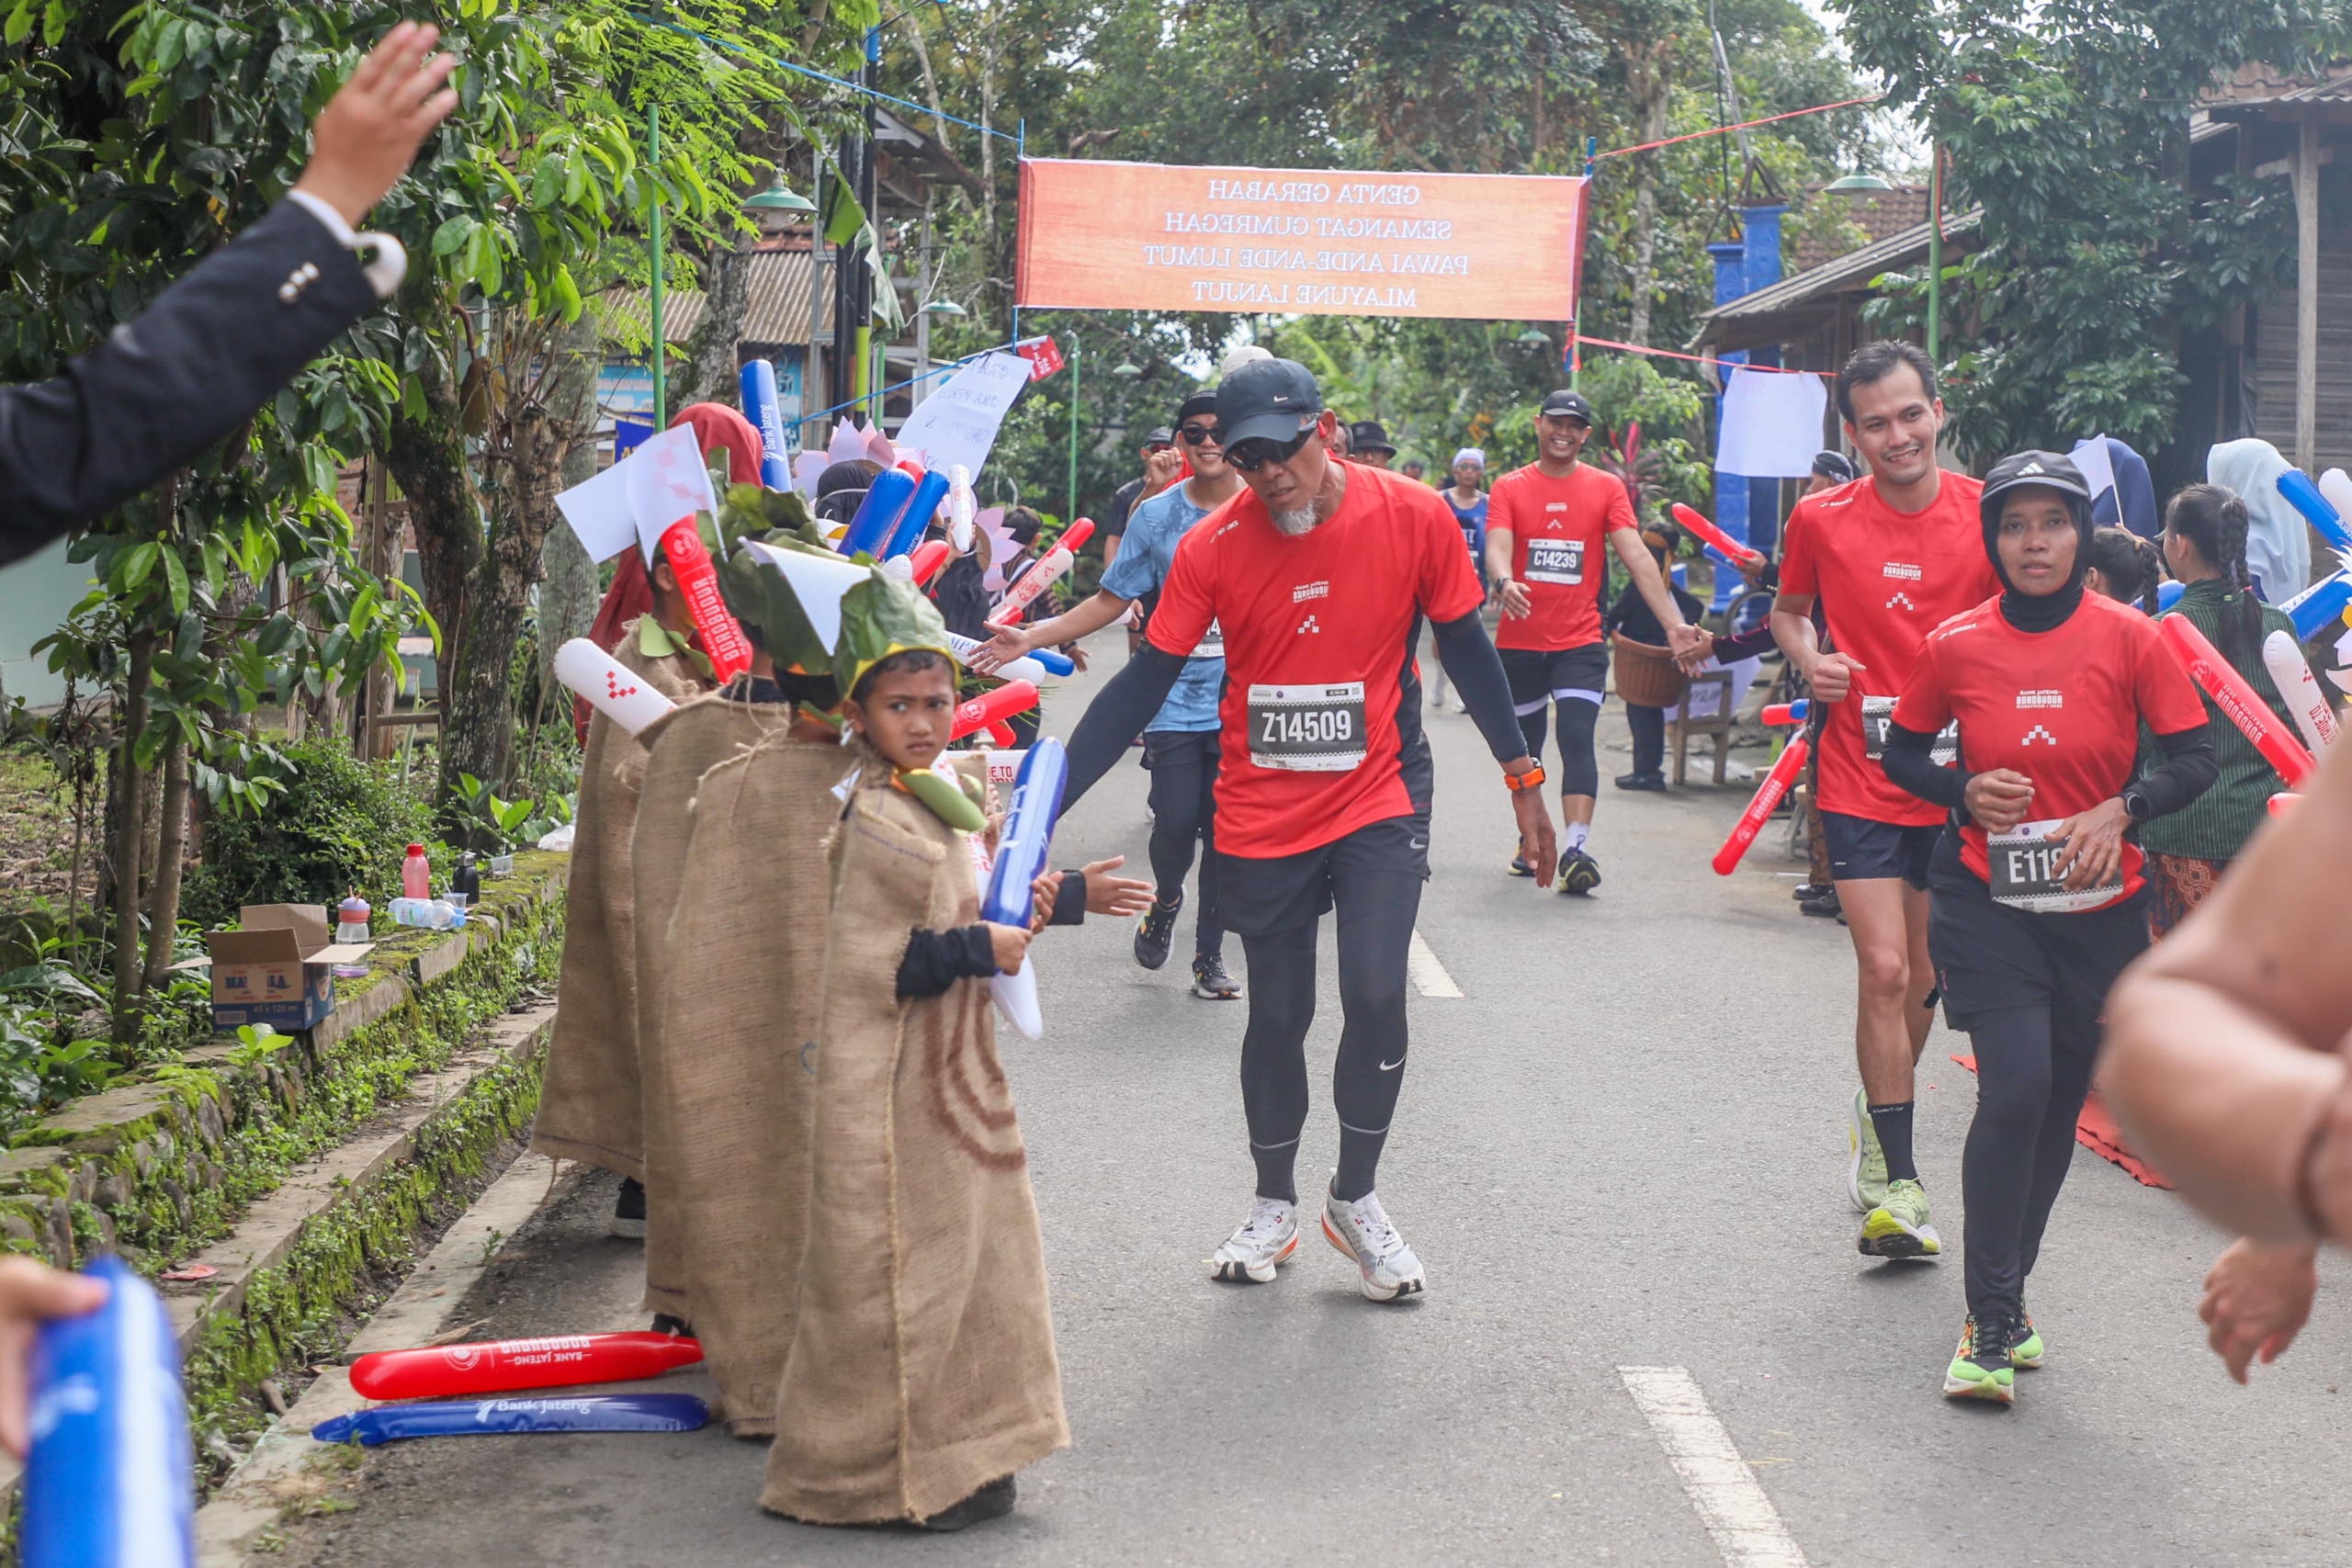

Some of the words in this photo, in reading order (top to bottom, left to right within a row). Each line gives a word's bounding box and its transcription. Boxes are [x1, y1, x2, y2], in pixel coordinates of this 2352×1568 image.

[760, 404, 776, 430] Jateng
[762, 430, 776, 450] Bank
[905, 533, 920, 556] ateng
[1533, 550, 1577, 569] C14239
[1883, 566, 1922, 577] BOROBUDUR
[689, 594, 709, 629] JATENG
[692, 577, 741, 662] BOROBUDUR
[1949, 623, 1977, 636] BROOKS
[2300, 623, 2324, 644] ateng
[704, 630, 718, 657] BANK
[2016, 695, 2063, 705] BOROBUDUR
[2222, 683, 2236, 699] 2025
[2216, 688, 2264, 745] BOROBUDUR
[2239, 703, 2267, 734] MARATHON
[2309, 705, 2321, 719] TO
[1261, 709, 1351, 742] Z14509
[1000, 766, 1012, 778] TO
[514, 1351, 552, 1365] JATENG
[554, 1351, 582, 1362] BANK
[497, 1400, 537, 1411] Bank
[539, 1400, 591, 1415] Jateng
